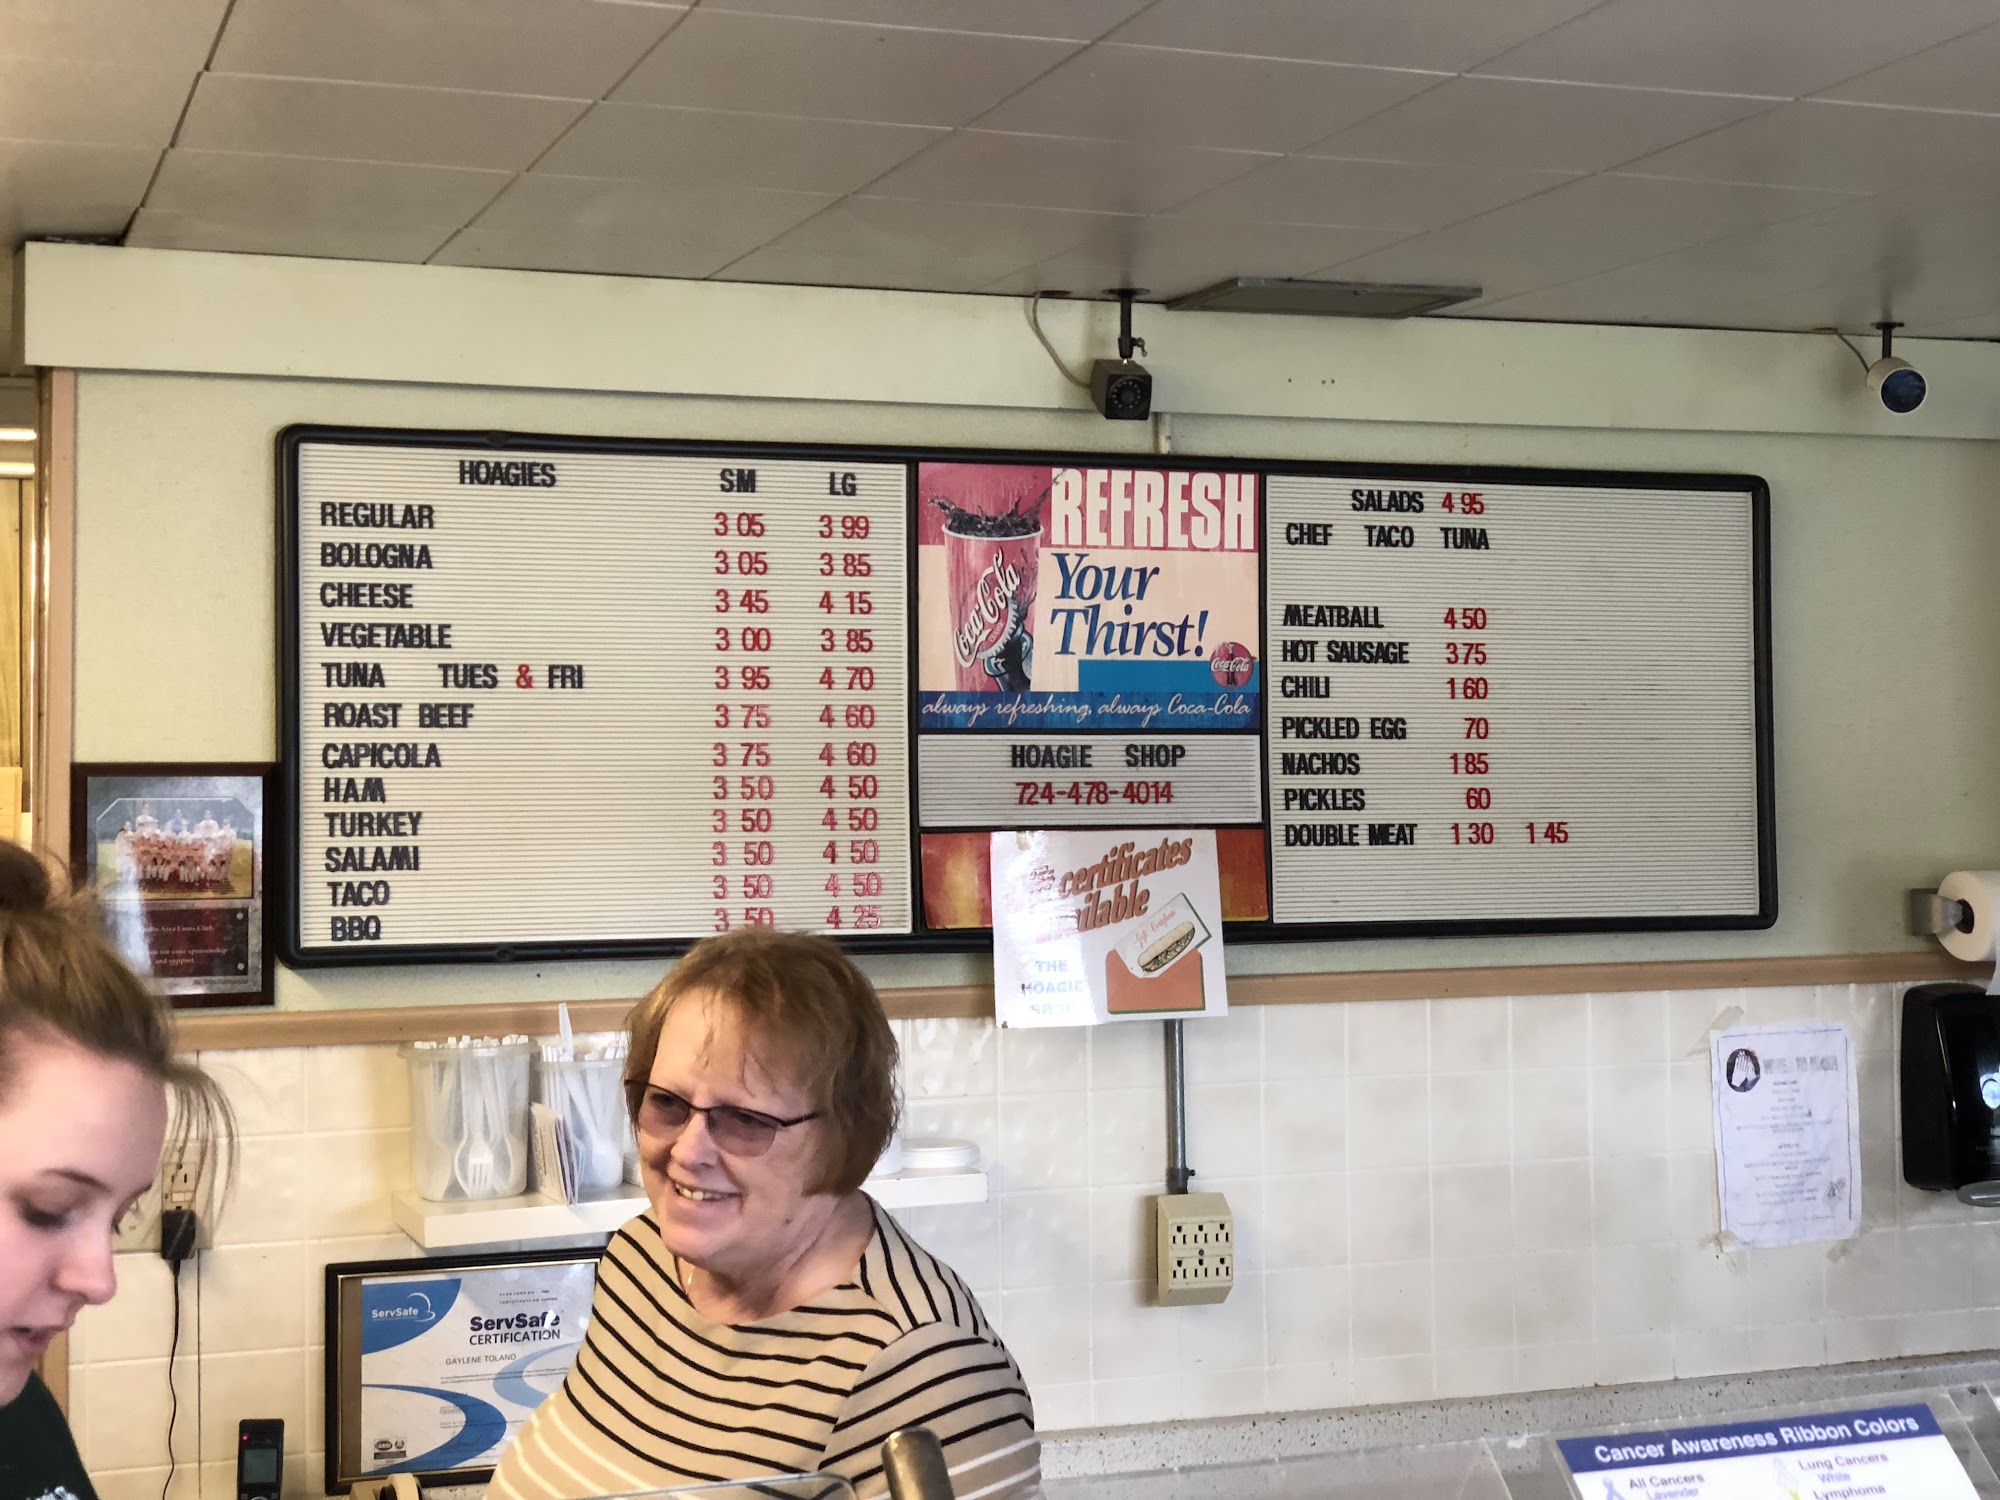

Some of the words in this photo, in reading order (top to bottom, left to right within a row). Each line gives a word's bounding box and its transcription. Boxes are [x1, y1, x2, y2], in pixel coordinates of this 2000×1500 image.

[459, 460, 556, 487] HOAGIES
[720, 469, 756, 493] SM
[829, 472, 857, 496] LG
[1051, 468, 1255, 550] REFRESH
[1351, 489, 1424, 513] SALADS
[1442, 492, 1454, 513] 4
[1461, 493, 1485, 514] 95
[321, 502, 434, 529] REGULAR
[714, 512, 729, 537] 3
[737, 513, 765, 537] 05
[819, 515, 833, 539] 3
[841, 515, 870, 539] 99
[1285, 523, 1333, 545] CHEF
[1364, 525, 1414, 548] TACO
[1440, 527, 1490, 550] TUNA
[321, 542, 432, 568] BOLOGNA
[715, 550, 729, 575] 3
[738, 551, 768, 575] 05
[820, 552, 834, 576] 3
[843, 553, 872, 577] 85
[1051, 553, 1160, 601] Your
[320, 583, 413, 608] CHEESE
[715, 589, 730, 613] 3
[740, 590, 769, 614] 45
[819, 591, 834, 614] 4
[844, 591, 873, 615] 15
[1283, 604, 1384, 628] MEATBALL
[321, 623, 451, 648] VEGETABLE
[715, 627, 730, 651] 3
[742, 627, 772, 652] 00
[821, 628, 835, 652] 3
[846, 629, 873, 653] 85
[1050, 603, 1209, 657] Thirst!
[1282, 640, 1318, 663] HOT
[1327, 640, 1409, 664] SAUSAGE
[322, 662, 385, 687] TUNA
[438, 664, 498, 688] TUES
[516, 663, 533, 689] &
[548, 665, 583, 689] FRI
[715, 666, 730, 690] 3
[742, 666, 770, 690] 95
[819, 667, 835, 690] 4
[847, 667, 874, 691] 70
[1281, 676, 1330, 698] CHILI
[324, 703, 401, 728] ROAST
[419, 703, 473, 728] BEEF
[715, 704, 730, 729] 3
[741, 704, 770, 729] 75
[819, 705, 835, 729] 4
[846, 704, 875, 729] 60
[922, 694, 990, 727] always
[1097, 695, 1162, 726] always
[1167, 694, 1251, 716] Coca-Cola
[1281, 717, 1360, 739] PICKLED
[1370, 717, 1406, 740] EGG
[1464, 718, 1489, 740] 70
[322, 743, 441, 768] CAPICOLA
[713, 742, 728, 767] 3
[741, 743, 771, 767] 75
[819, 742, 835, 767] 4
[847, 741, 877, 767] 60
[1010, 745, 1093, 768] HOAGIE
[1124, 744, 1185, 767] SHOP
[1280, 752, 1360, 775] NACHOS
[324, 777, 385, 803] HAM
[713, 775, 728, 800] 3
[740, 775, 774, 800] 50
[820, 775, 836, 799] 4
[848, 775, 878, 799] 50
[1016, 781, 1173, 806] 724-478-4014
[1282, 788, 1365, 811] PICKLES
[1466, 788, 1491, 810] 60
[325, 812, 422, 837] TURKEY
[712, 808, 727, 833] 3
[741, 808, 772, 832] 50
[821, 808, 838, 831] 4
[848, 807, 878, 831] 50
[1283, 824, 1360, 846] DOUBLE
[1366, 824, 1417, 846] MEAT
[325, 846, 419, 872] SALAMI
[712, 841, 728, 866] 3
[743, 841, 774, 866] 50
[822, 840, 838, 864] 4
[850, 839, 879, 864] 50
[1058, 837, 1193, 899] certificates
[327, 880, 389, 906] TACO
[713, 875, 728, 900] 3
[743, 874, 773, 899] 50
[825, 873, 840, 897] 4
[853, 872, 882, 897] 50
[331, 916, 381, 941] BBQ
[714, 908, 730, 932] 3
[826, 906, 842, 929] 4
[854, 904, 882, 929] 25
[372, 1307, 419, 1318] ServSafe
[469, 1329, 560, 1346] CERTIFICATION
[445, 1355, 482, 1366] GAYLENE
[485, 1354, 517, 1362] TOLAND
[1594, 1442, 1666, 1463] Cancer
[1671, 1431, 1778, 1456] Awareness
[1779, 1424, 1852, 1444] Ribbon
[1853, 1417, 1920, 1436] Colors
[1798, 1459, 1833, 1471] Lung
[1835, 1453, 1888, 1467] Cancers
[1629, 1478, 1647, 1490] All
[1650, 1473, 1705, 1488] Cancers
[1818, 1472, 1852, 1483] White
[1813, 1484, 1886, 1500] Lymphoma
